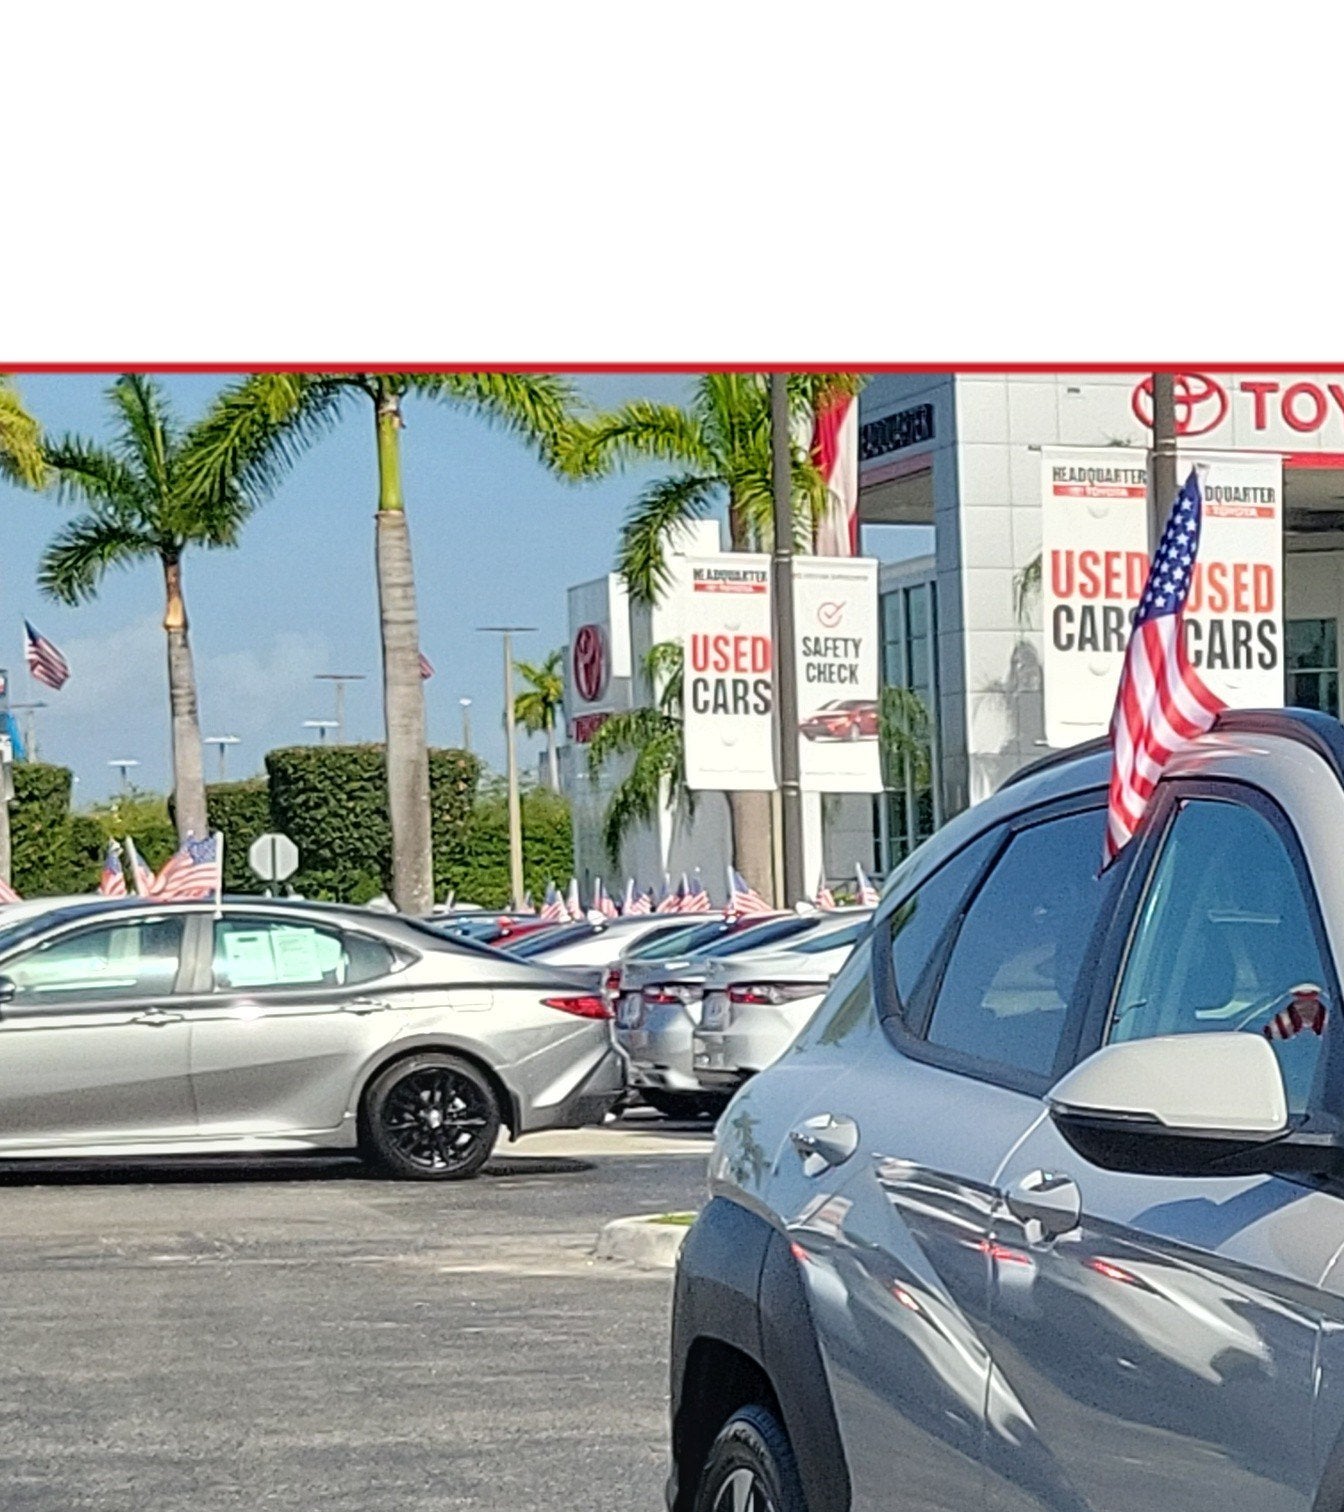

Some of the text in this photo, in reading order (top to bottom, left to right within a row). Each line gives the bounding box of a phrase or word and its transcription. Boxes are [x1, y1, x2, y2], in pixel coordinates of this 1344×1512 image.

[1205, 486, 1275, 504] DQUARTER
[1051, 550, 1149, 599] USED
[1053, 604, 1137, 651] CAR
[1184, 619, 1278, 670] CARS
[692, 634, 772, 674] USED
[802, 636, 862, 659] SAFETY
[806, 662, 859, 684] CHECK
[692, 677, 772, 716] CARS
